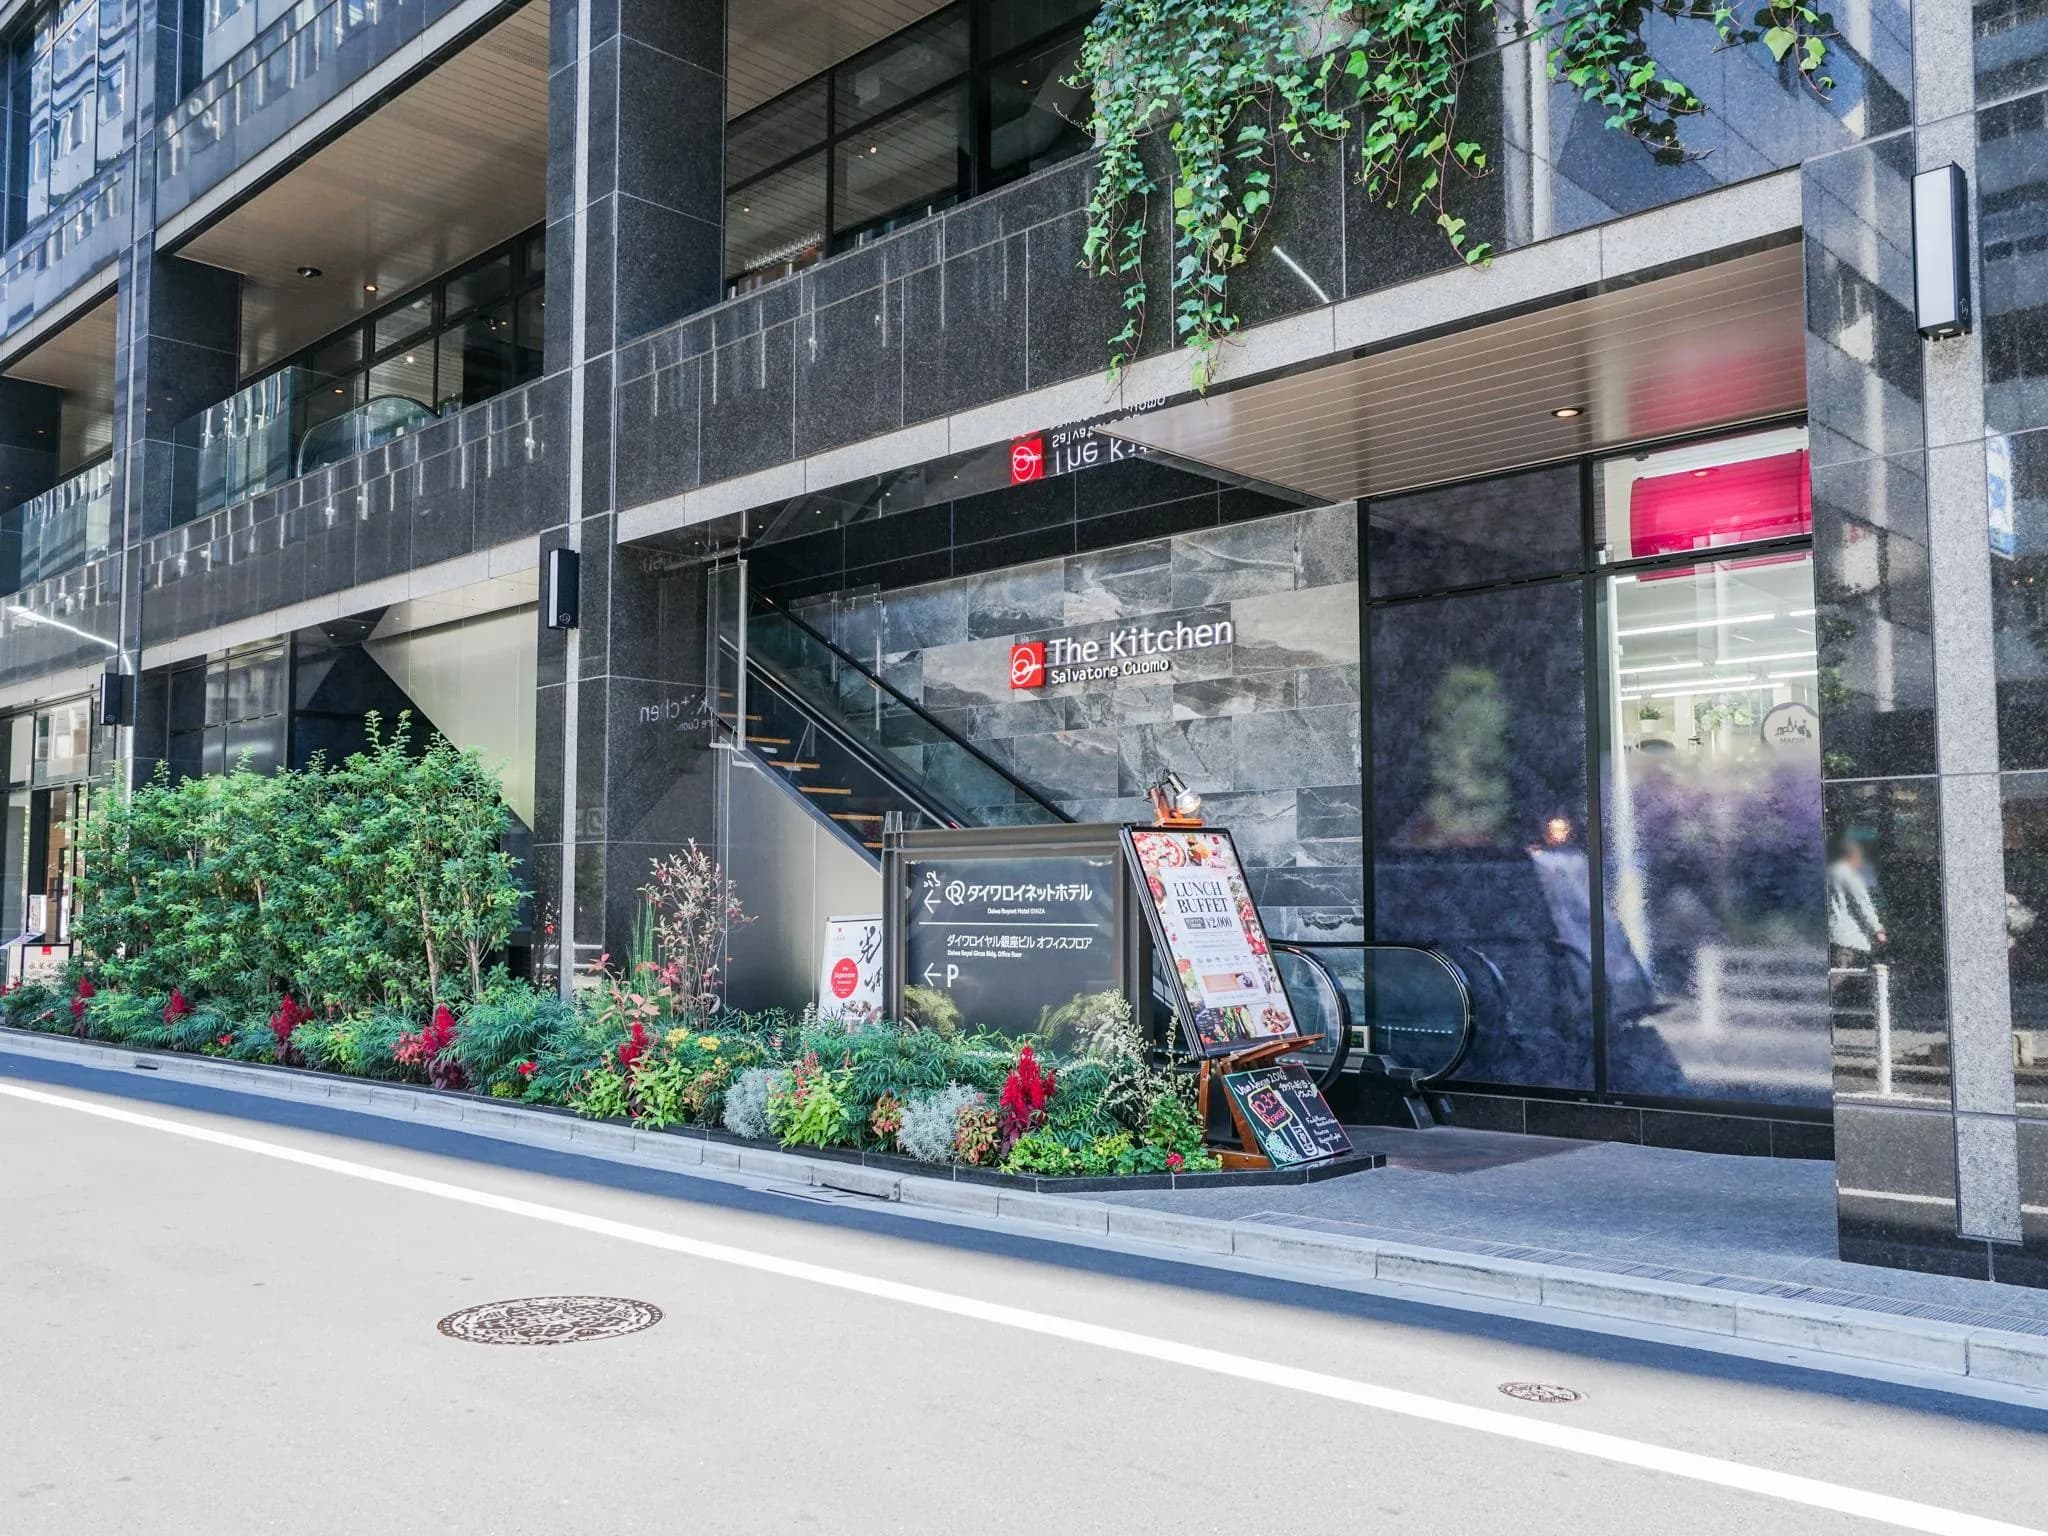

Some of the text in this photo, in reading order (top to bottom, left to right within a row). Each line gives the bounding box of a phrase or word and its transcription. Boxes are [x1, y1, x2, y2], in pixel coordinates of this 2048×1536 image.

[1049, 620, 1233, 666] The Kitchen
[1051, 659, 1170, 684] Salvatore Cuomo
[1173, 881, 1222, 897] LUNCH
[1176, 897, 1229, 914] BUFFET
[1036, 936, 1093, 949] オフィスフロア
[947, 964, 959, 988] P
